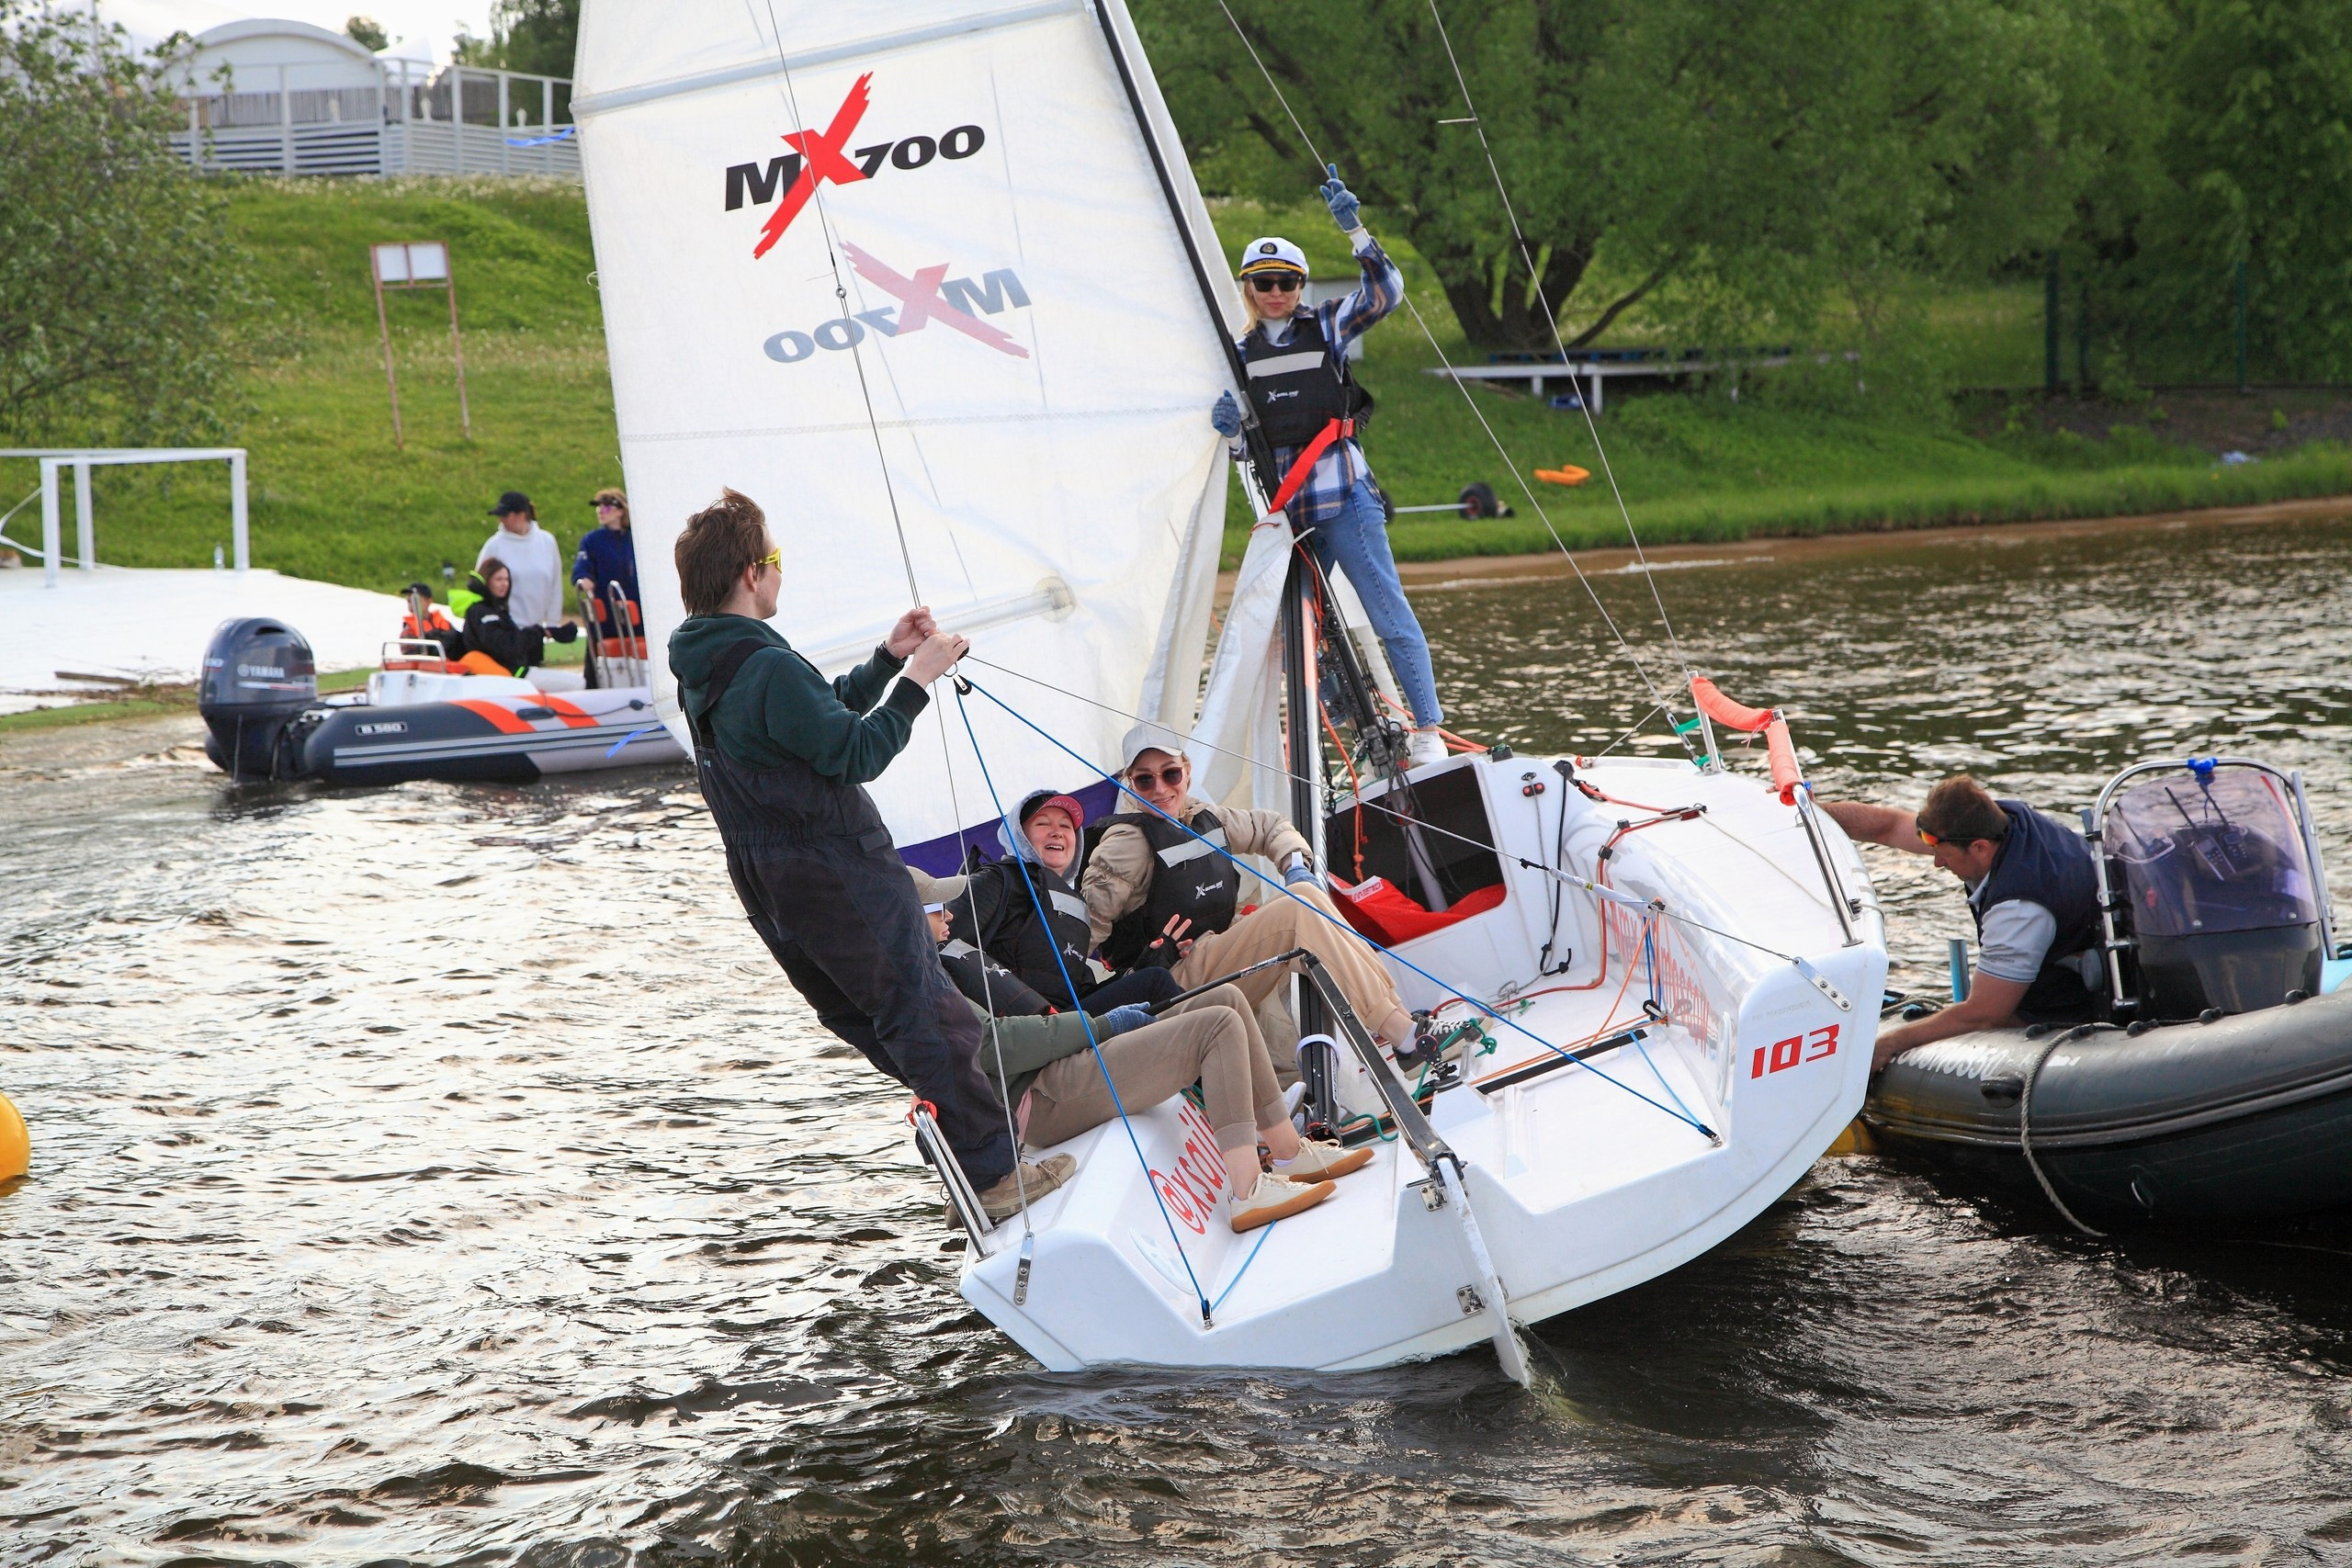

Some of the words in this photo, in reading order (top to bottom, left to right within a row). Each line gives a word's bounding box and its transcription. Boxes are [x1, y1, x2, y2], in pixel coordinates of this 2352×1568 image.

[725, 72, 986, 260] MX700
[250, 664, 285, 679] YAMAHA
[1751, 1023, 1840, 1079] 103
